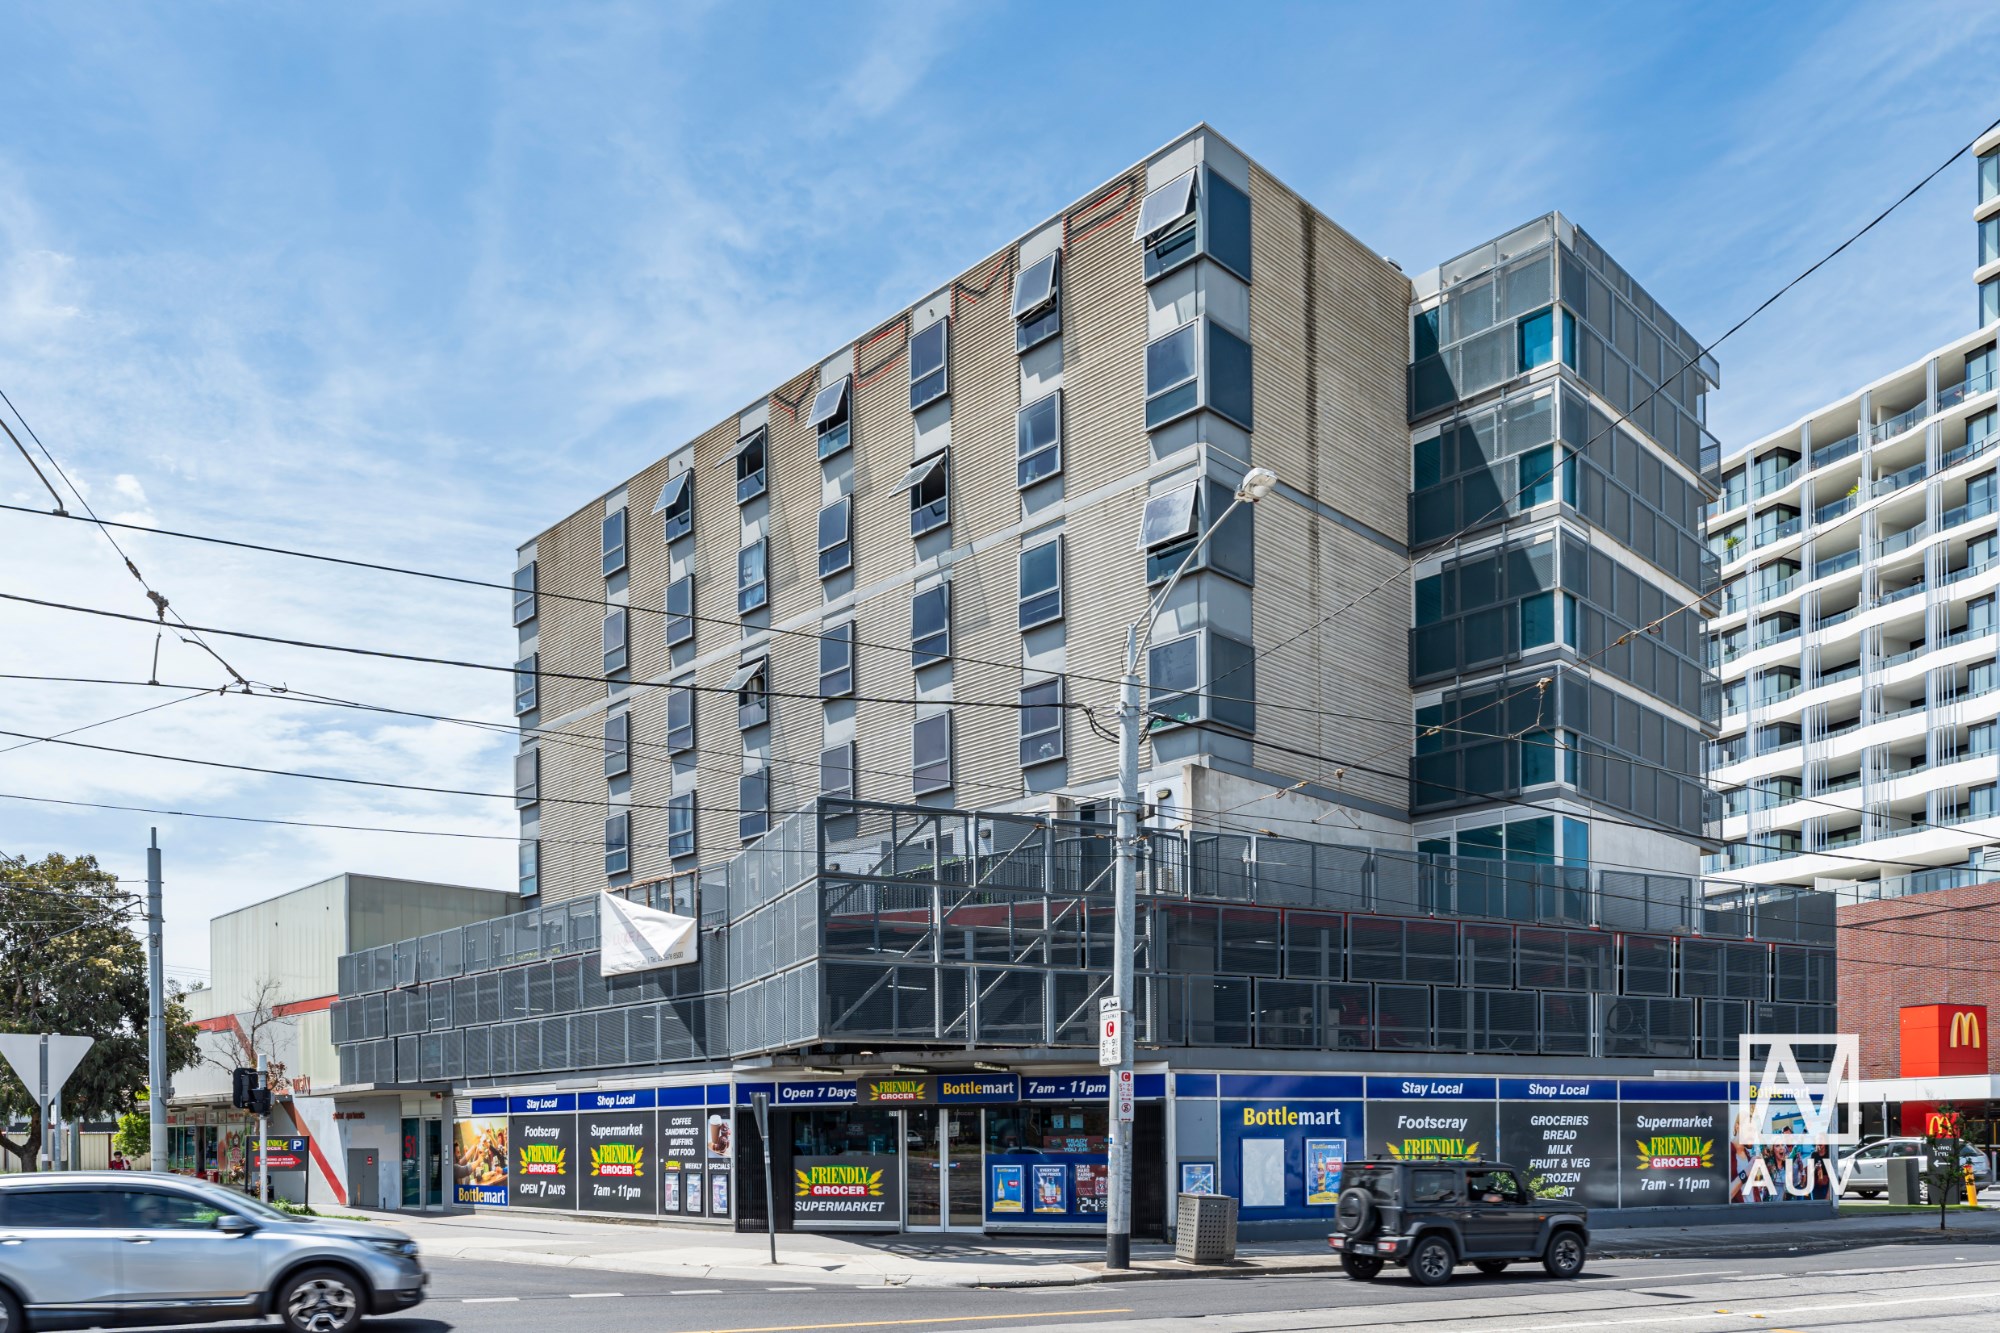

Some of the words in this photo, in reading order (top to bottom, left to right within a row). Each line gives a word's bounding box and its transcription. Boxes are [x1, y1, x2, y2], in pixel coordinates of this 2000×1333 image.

[783, 1088, 814, 1100] Open
[817, 1088, 825, 1097] 7
[828, 1087, 857, 1100] Days
[879, 1081, 916, 1093] FRIENDLY
[943, 1081, 1014, 1095] Bottlemart
[1029, 1082, 1055, 1093] 7am
[1070, 1081, 1106, 1096] 11pm
[1402, 1082, 1428, 1096] Stay
[1431, 1083, 1463, 1094] Local
[1529, 1084, 1557, 1097] Shop
[1560, 1084, 1589, 1095] Local
[1750, 1085, 1810, 1098] Bottlemart
[527, 1098, 539, 1110] Stay
[541, 1098, 558, 1109] Local
[597, 1095, 614, 1107] Shop
[616, 1094, 635, 1105] Local
[671, 1117, 692, 1125] COFFEE
[1243, 1106, 1341, 1126] Bottlemart
[1531, 1116, 1589, 1126] GROCERIES
[1398, 1116, 1468, 1132] Footscray
[1637, 1116, 1713, 1131] Supermarket
[525, 1126, 560, 1139] Footscray
[591, 1124, 643, 1139] Supermarket
[665, 1128, 698, 1136] SANDWICHES
[1543, 1130, 1577, 1140] BREAD
[293, 1140, 302, 1149] P
[404, 1135, 416, 1158] 51
[1404, 1139, 1464, 1160] FRIENDLY
[1548, 1145, 1572, 1154] MILK
[1651, 1137, 1701, 1156] FRIENDLY
[528, 1145, 558, 1162] FRIENDLY
[599, 1145, 634, 1163] FRIENDLY
[529, 1164, 556, 1173] GROCER
[1530, 1159, 1559, 1168] FRUIT
[1561, 1159, 1568, 1168] &
[1570, 1158, 1590, 1168] VEG
[1653, 1158, 1698, 1167] GROCER
[601, 1165, 632, 1174] GROCER
[811, 1167, 869, 1184] FRIENDLY
[521, 1184, 538, 1194] OPEN
[540, 1181, 547, 1197] 7
[548, 1184, 566, 1195] DAYS
[814, 1186, 865, 1195] GROCER
[1641, 1179, 1666, 1190] 7am
[1678, 1177, 1710, 1192] 11pm
[459, 1187, 505, 1204] Bottlemart
[593, 1184, 610, 1196] 7am
[618, 1185, 641, 1200] 11pm
[795, 1201, 884, 1212] SUPERMARKET
